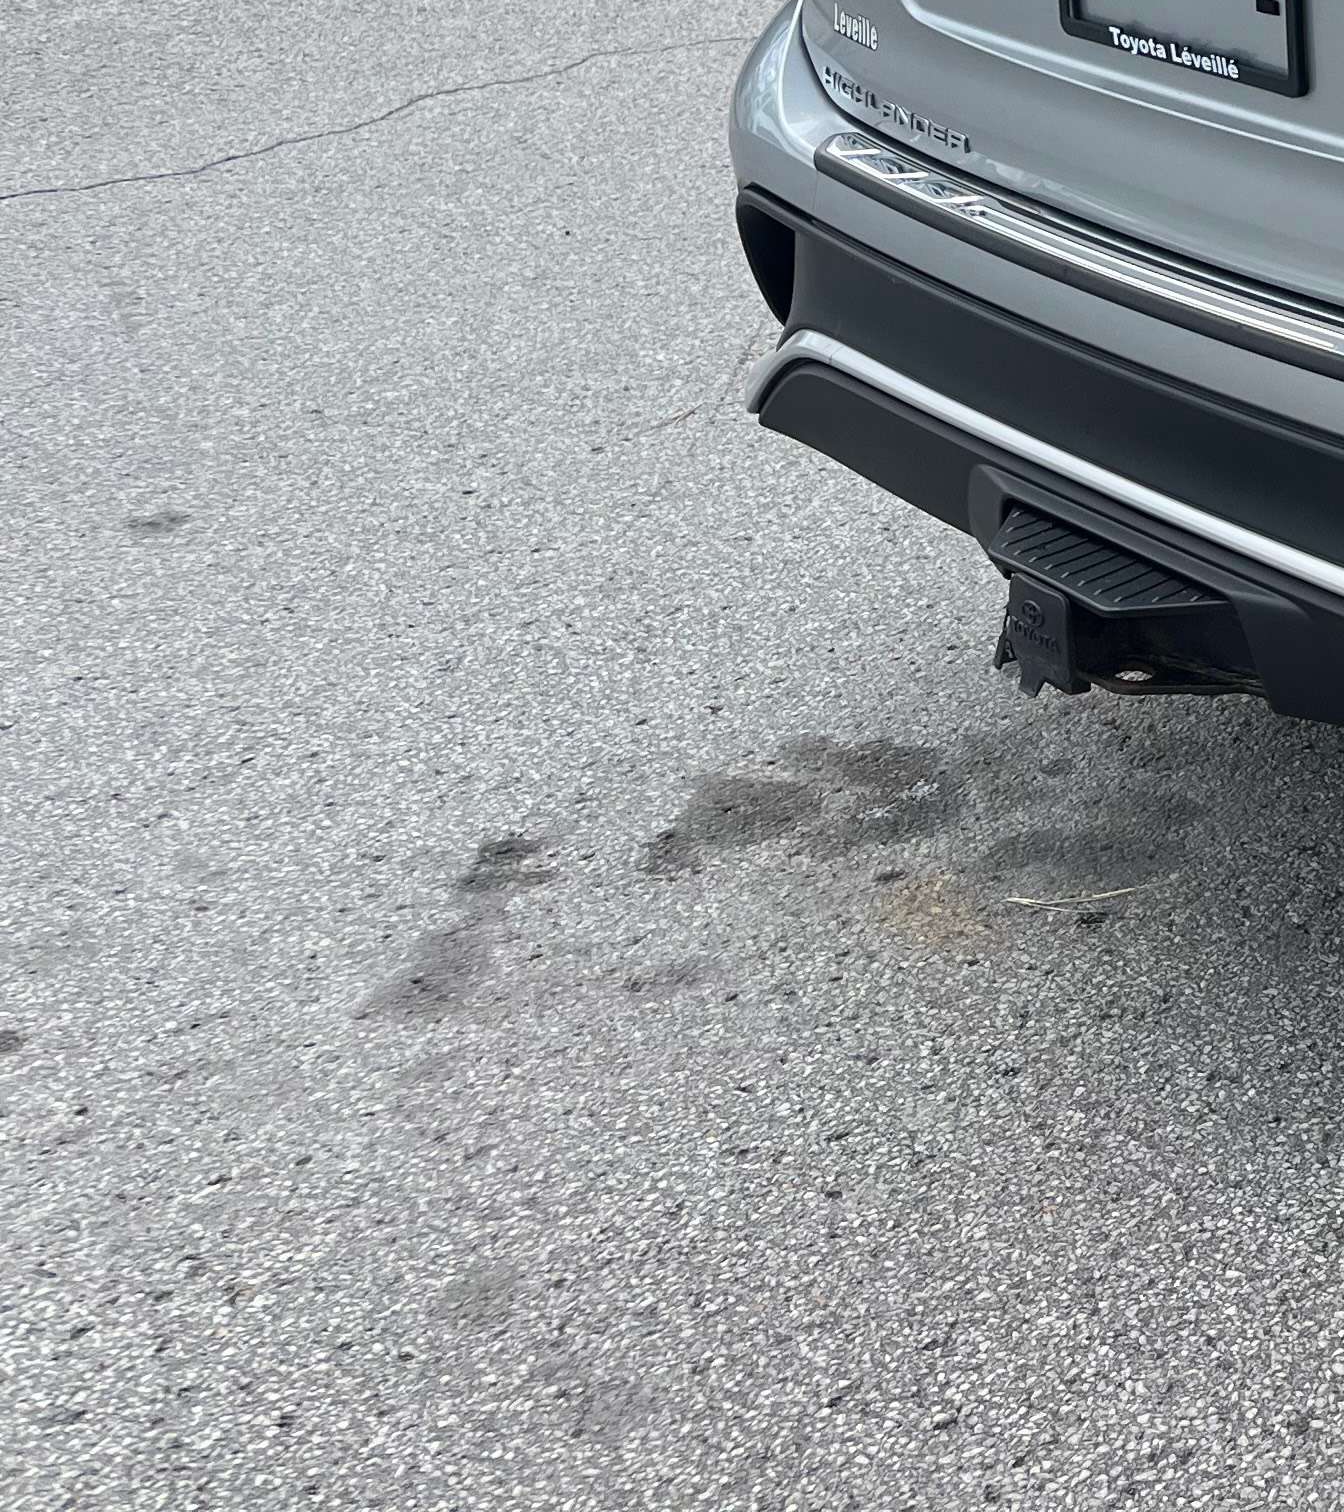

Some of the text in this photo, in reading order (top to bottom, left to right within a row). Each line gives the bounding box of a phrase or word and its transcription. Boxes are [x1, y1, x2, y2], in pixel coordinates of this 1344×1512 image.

[833, 2, 878, 51] Leveille
[1109, 26, 1239, 79] Toyota Léveillé
[824, 65, 971, 154] HIGHLANDER
